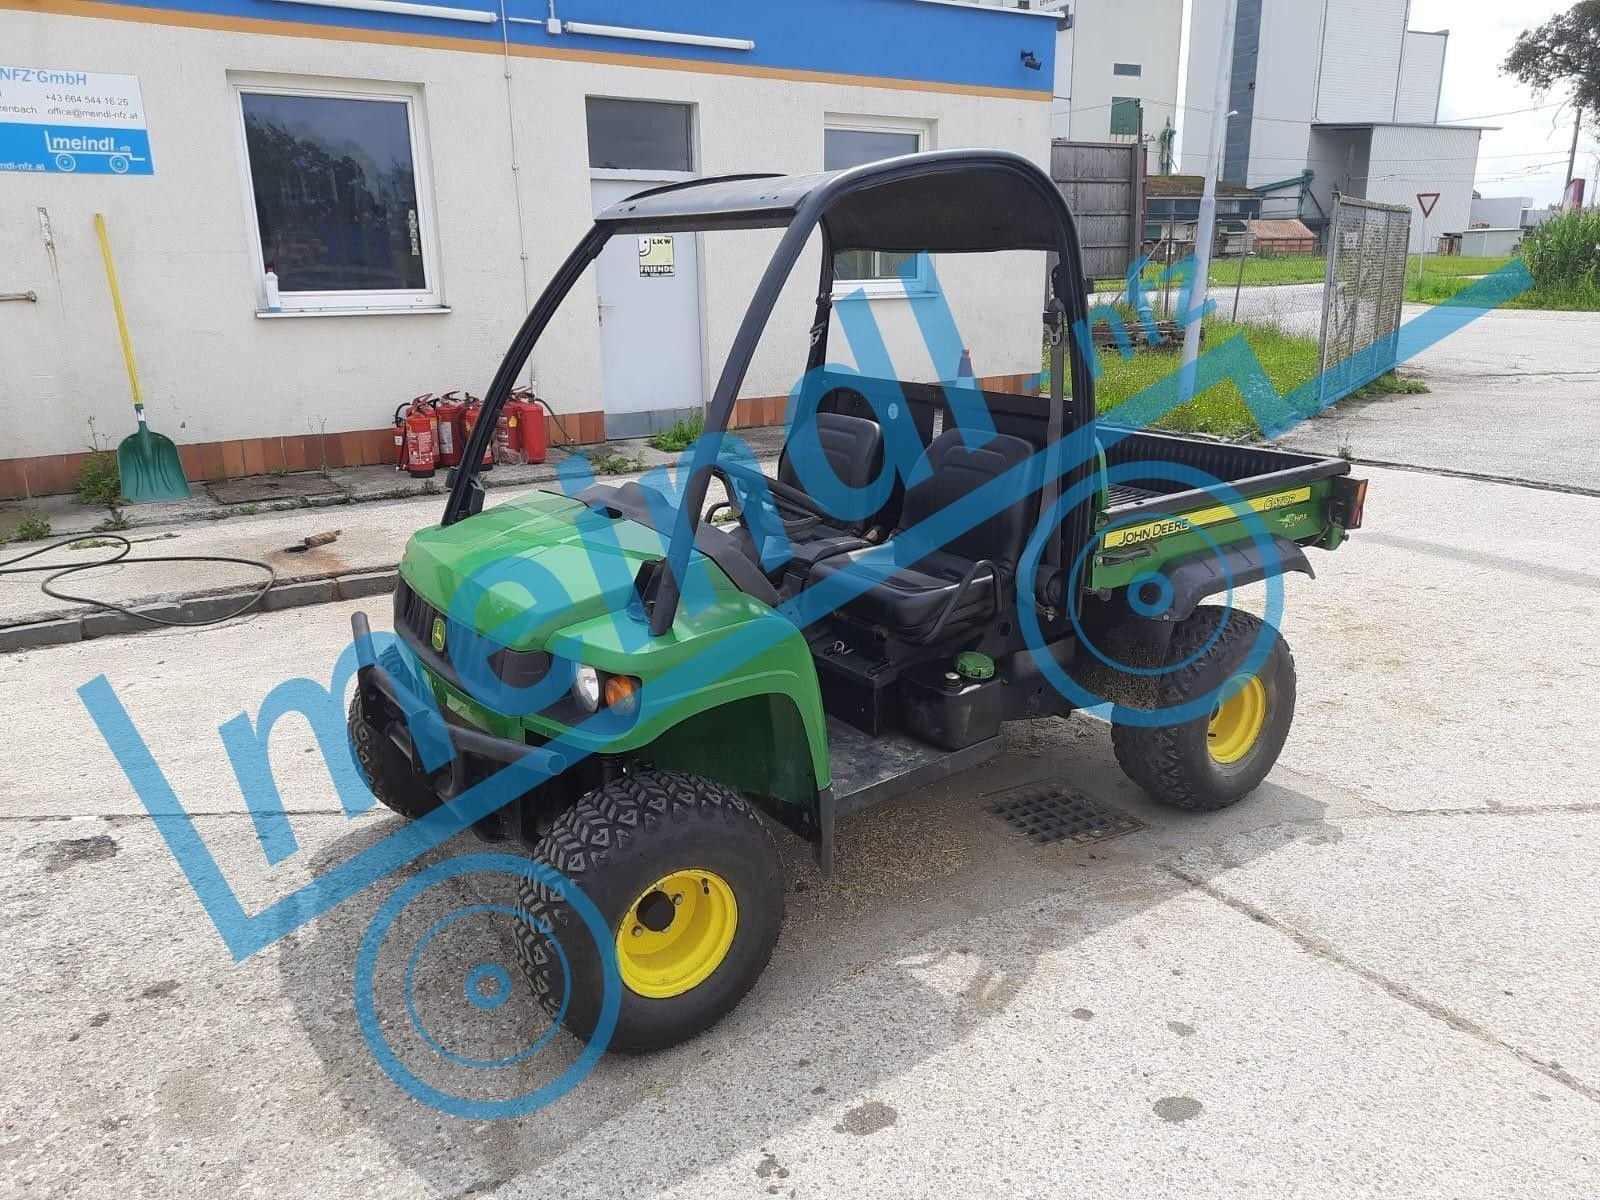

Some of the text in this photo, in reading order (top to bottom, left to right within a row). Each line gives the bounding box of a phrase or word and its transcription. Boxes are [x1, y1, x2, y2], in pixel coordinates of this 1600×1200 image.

[0, 68, 87, 85] NFZ GmbH
[46, 94, 63, 103] +43
[65, 94, 82, 103] 664
[85, 96, 101, 105] 544
[105, 97, 115, 106] 16
[47, 107, 138, 119] office@meindl-nfz.at
[53, 136, 114, 151] meindl
[1263, 494, 1296, 511] GATOR
[1118, 519, 1189, 546] JOHN DEERE
